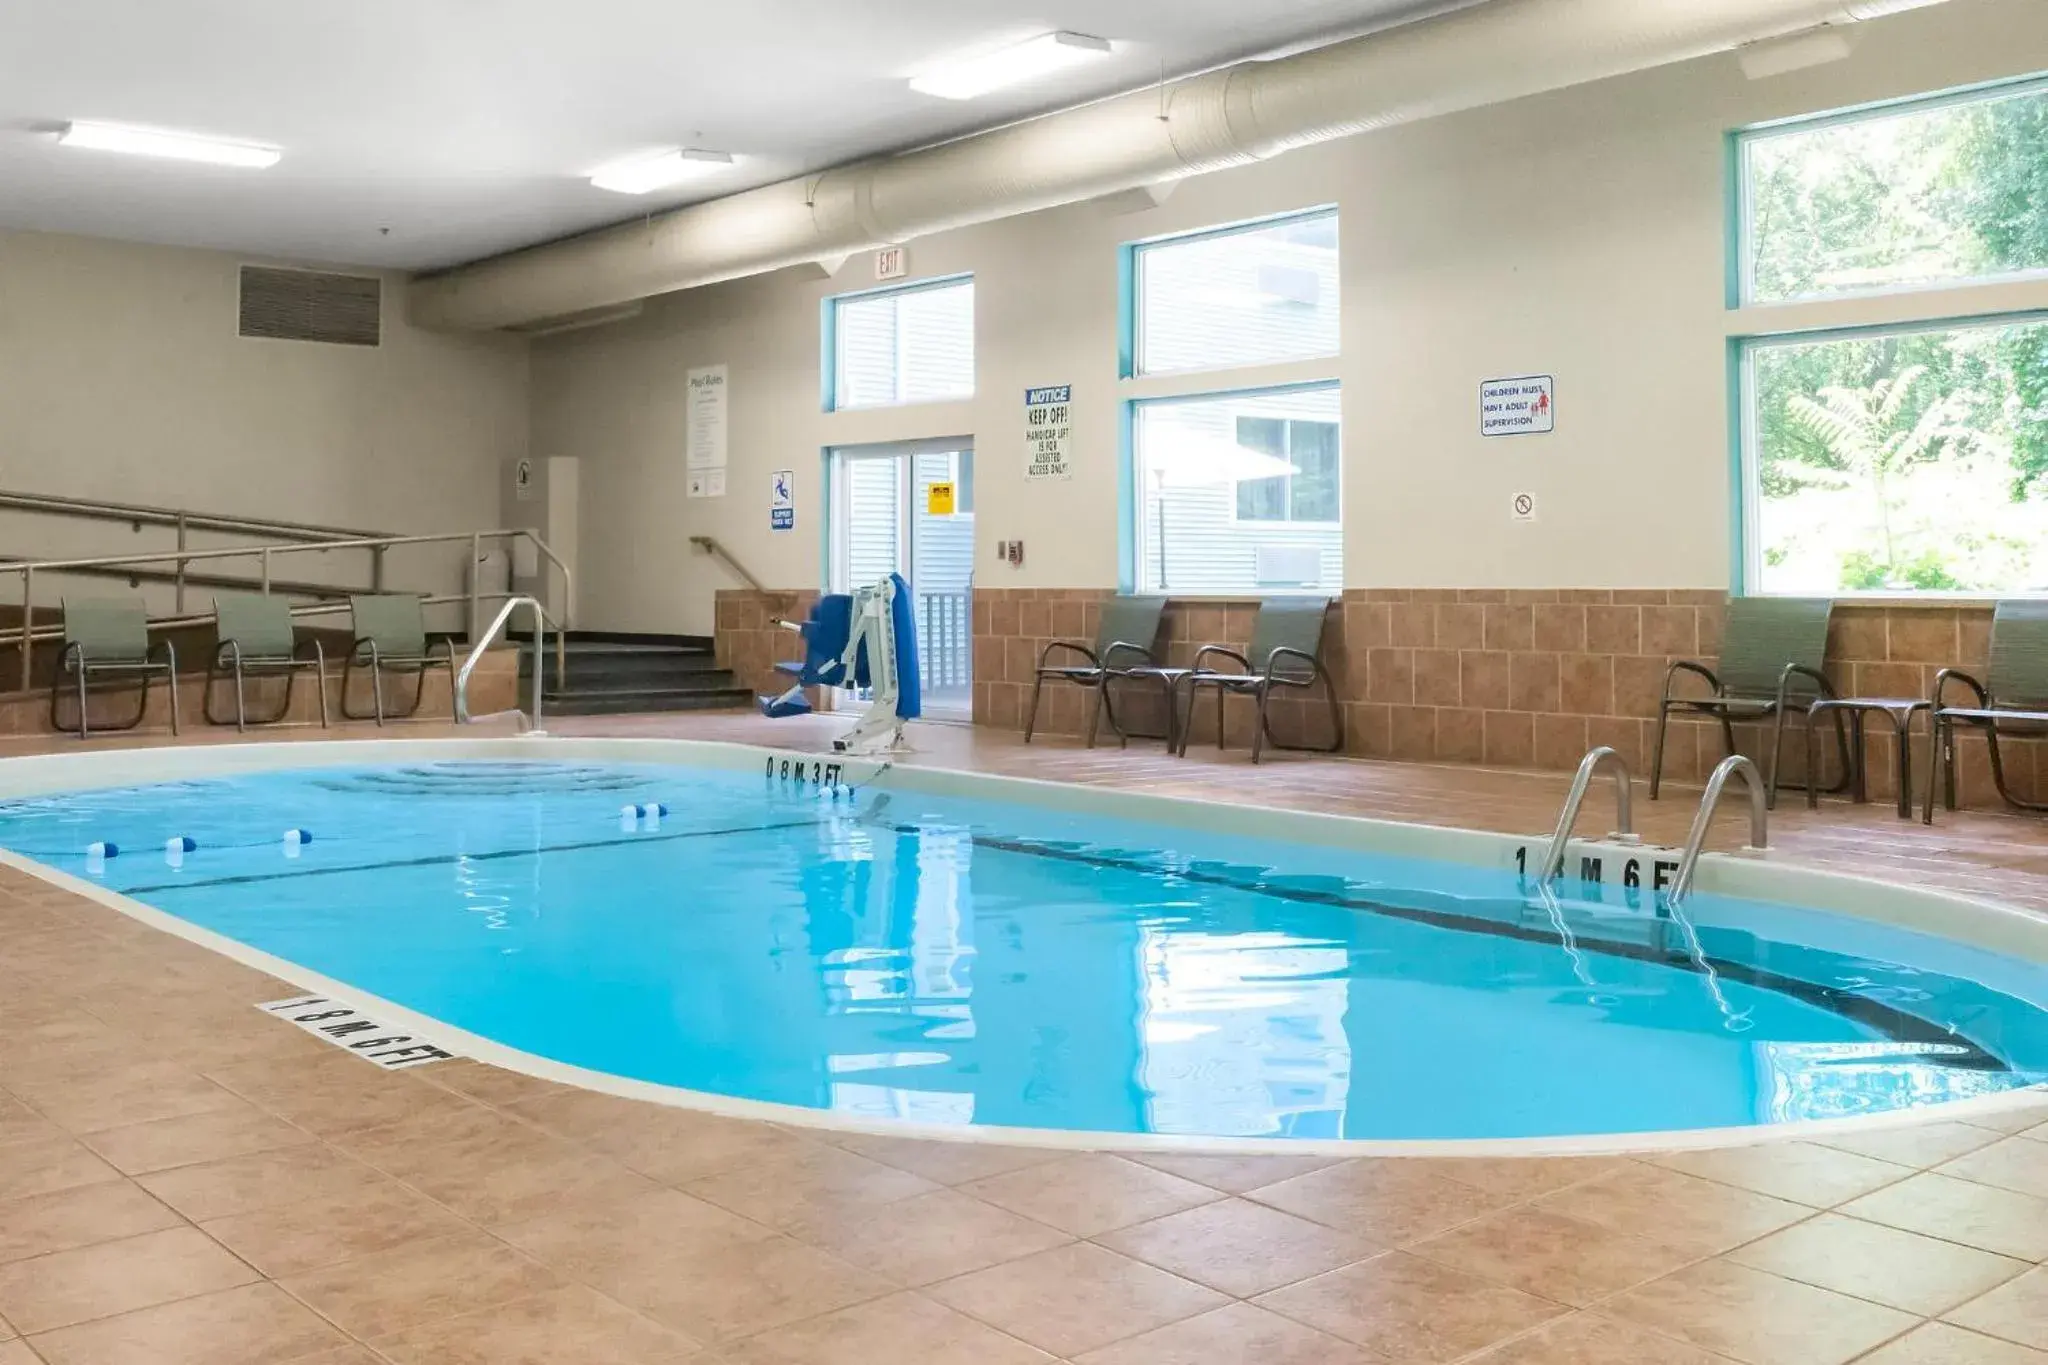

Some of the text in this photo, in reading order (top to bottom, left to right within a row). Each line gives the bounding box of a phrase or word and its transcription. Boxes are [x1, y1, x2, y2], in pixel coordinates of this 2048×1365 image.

[880, 249, 898, 274] EXIT
[1030, 387, 1068, 403] NOTICE
[1484, 385, 1543, 397] CHILDREN MUST
[1484, 402, 1528, 412] HAVE ADULT
[1029, 405, 1068, 424] KEEP OFF!
[1484, 417, 1533, 428] SUPERVISION
[1026, 429, 1056, 440] HANDICAP
[1038, 440, 1057, 451] IS FOR
[1035, 452, 1061, 463] ASSISTED
[1029, 464, 1048, 475] ACCESS
[812, 762, 820, 784] 3
[824, 763, 842, 787] FT
[1624, 858, 1640, 888] 6
[348, 1035, 413, 1049] 6
[367, 1044, 455, 1066] FT
